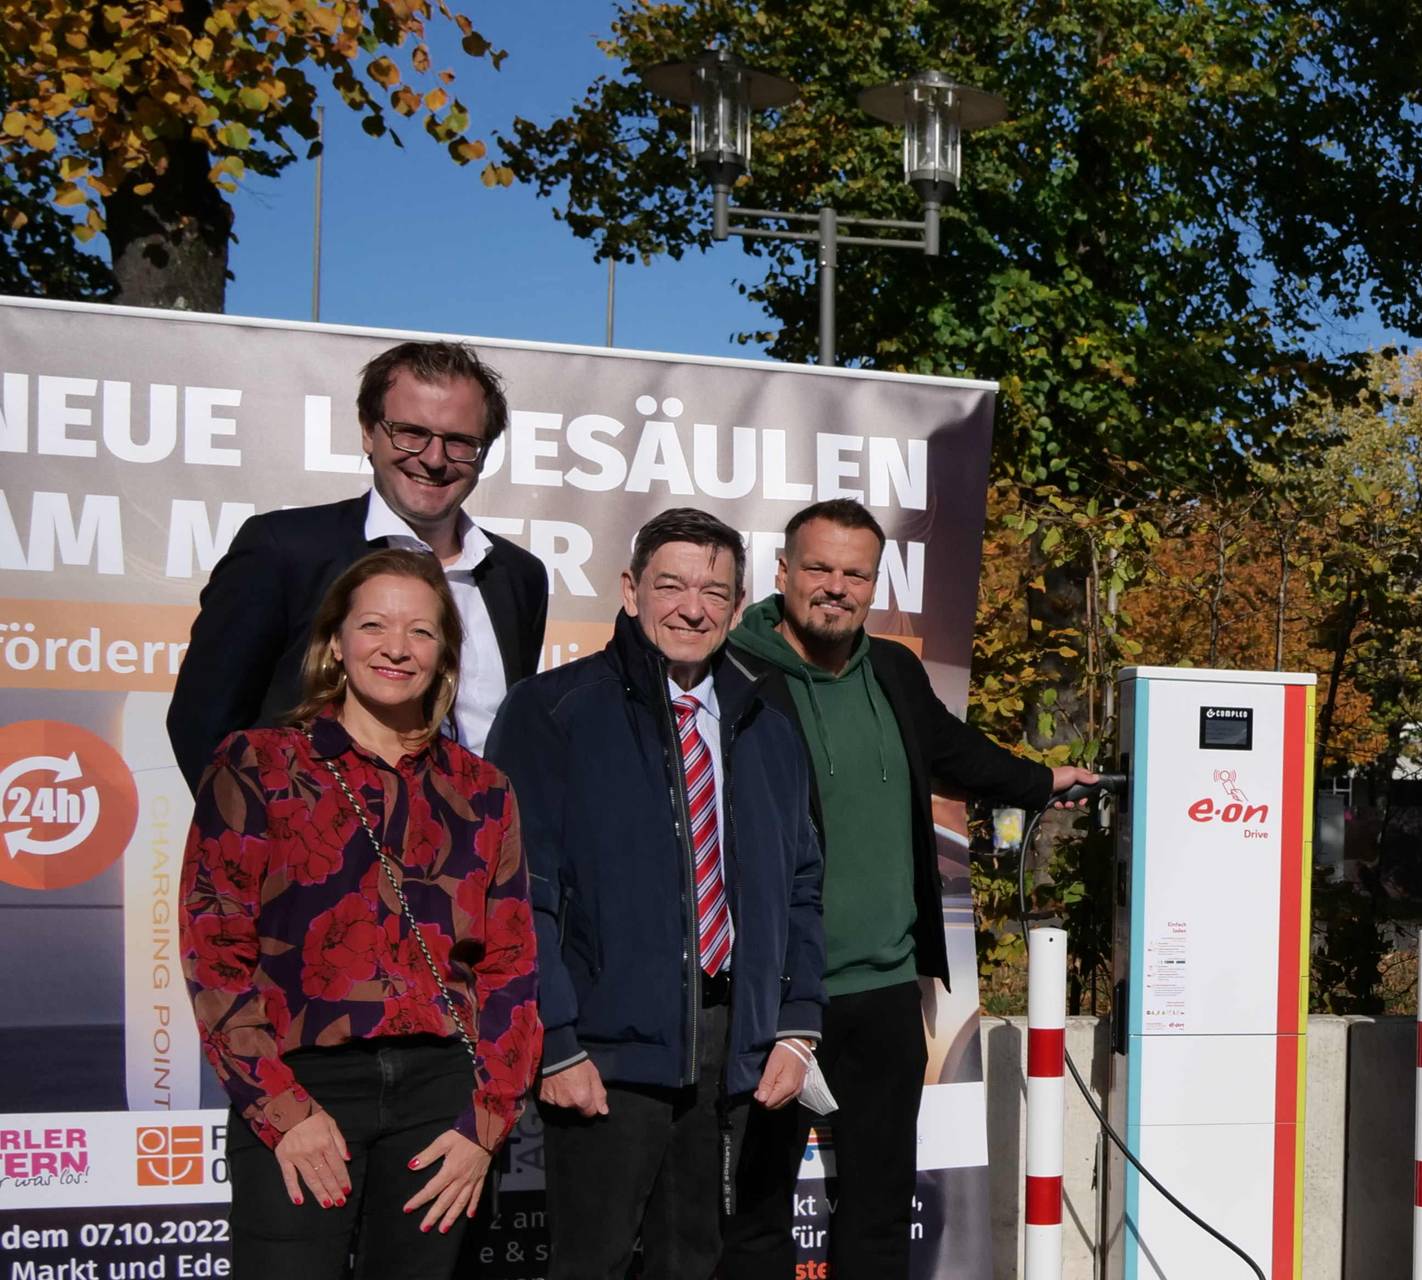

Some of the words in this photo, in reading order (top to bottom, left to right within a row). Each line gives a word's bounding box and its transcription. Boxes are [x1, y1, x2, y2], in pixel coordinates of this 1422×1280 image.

[304, 394, 928, 511] LESÄULEN
[7, 786, 82, 823] 24h
[1244, 829, 1269, 839] Drive
[151, 795, 171, 991] CHARGING
[152, 1004, 171, 1111] POINT
[1, 1225, 69, 1250] dem
[80, 1219, 230, 1247] 07.10.2022
[11, 1257, 99, 1280] Markt
[110, 1254, 166, 1280] und
